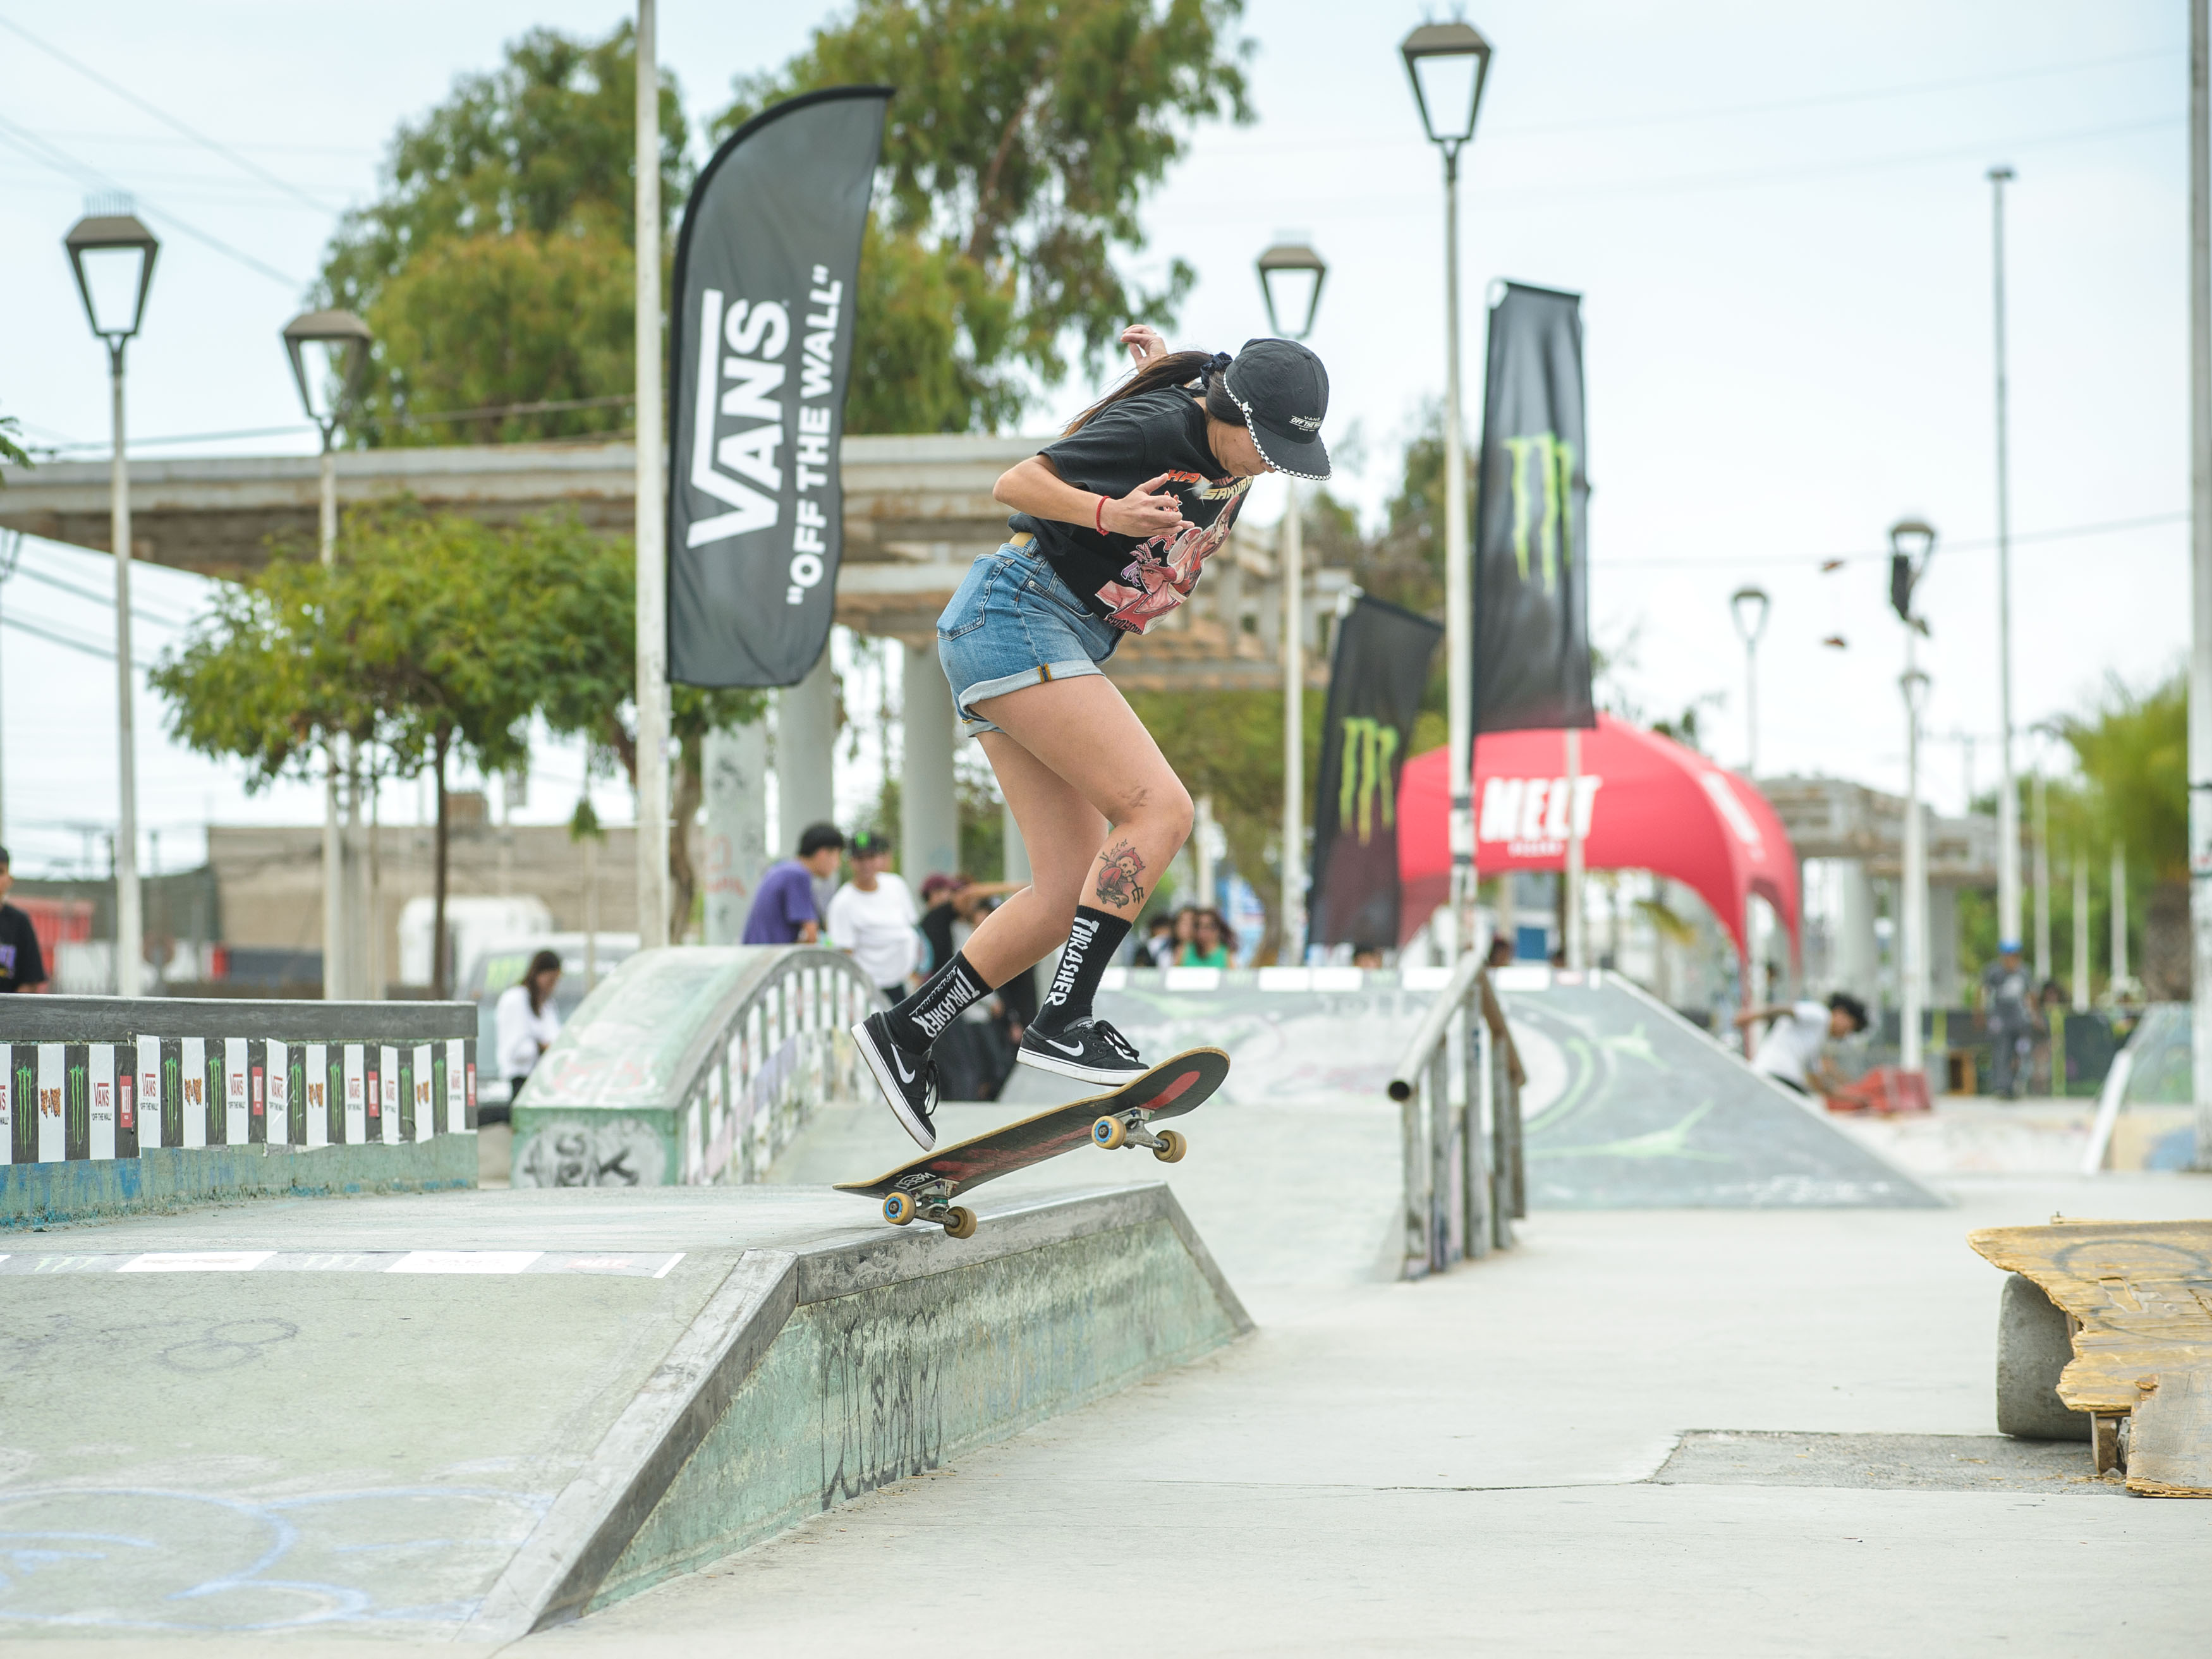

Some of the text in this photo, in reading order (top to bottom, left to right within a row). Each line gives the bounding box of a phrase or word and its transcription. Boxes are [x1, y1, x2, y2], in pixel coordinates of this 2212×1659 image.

[687, 288, 791, 549] VANS
[796, 406, 831, 491] THE
[1044, 916, 1100, 1006] THRASHER
[911, 966, 980, 1038] THRASHER
[94, 1083, 109, 1107] VANS
[142, 1073, 156, 1097] VANS
[230, 1074, 243, 1097] VANS
